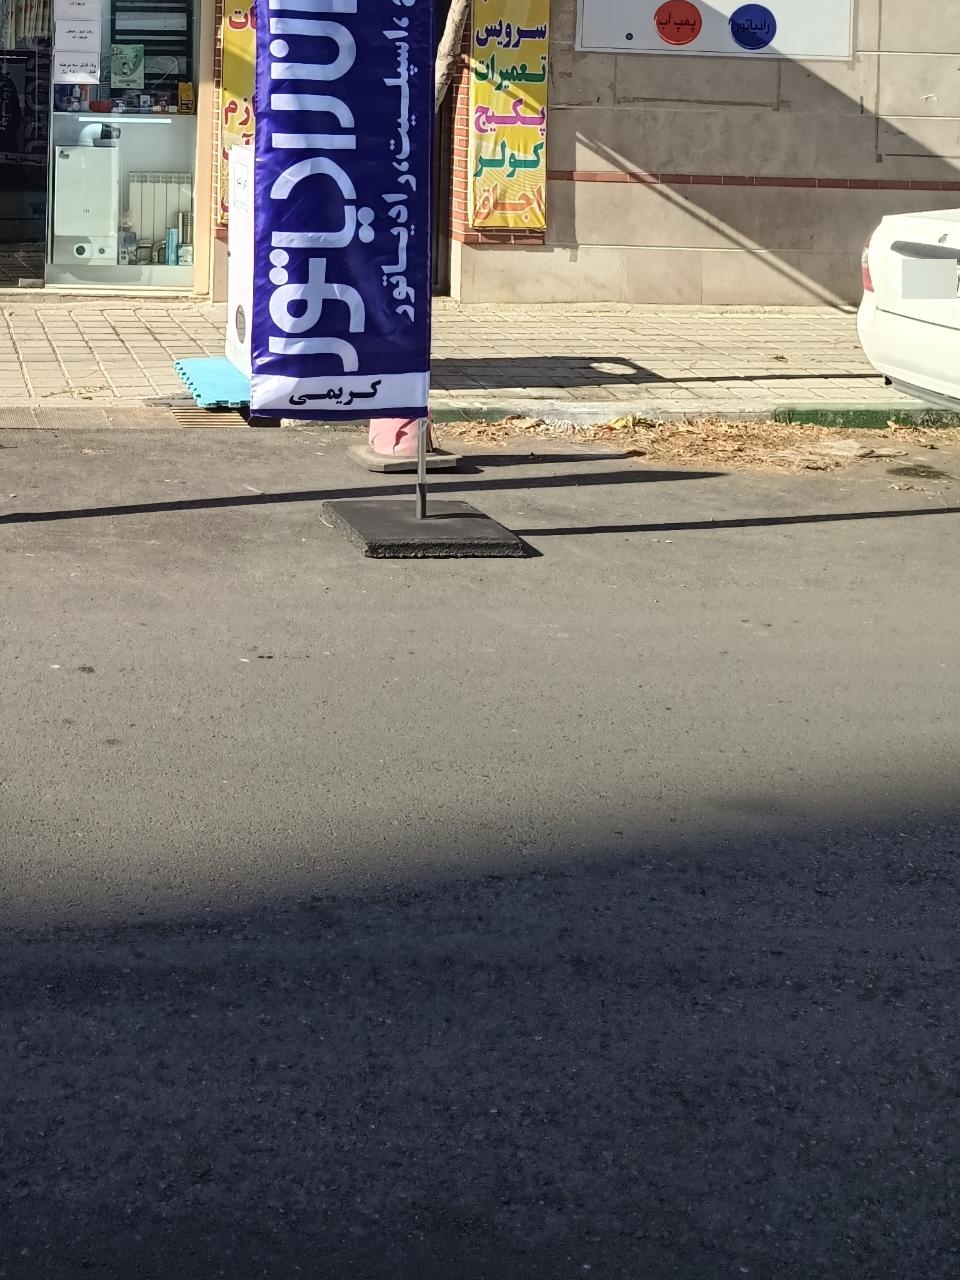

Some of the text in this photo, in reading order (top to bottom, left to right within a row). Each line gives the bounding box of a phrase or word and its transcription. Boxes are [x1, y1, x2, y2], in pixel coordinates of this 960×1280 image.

[475, 19, 547, 48] سرویس
[658, 12, 697, 33] پمپ آب
[733, 17, 771, 33] رادیاتور
[474, 53, 546, 91] تعمیرات
[473, 98, 546, 136] پکیج
[473, 140, 544, 178] کولر
[474, 183, 542, 221] اجاق
[268, 93, 376, 372] رادیاتور
[380, 174, 417, 322] رادیاتور
[288, 377, 382, 409] کریمی
